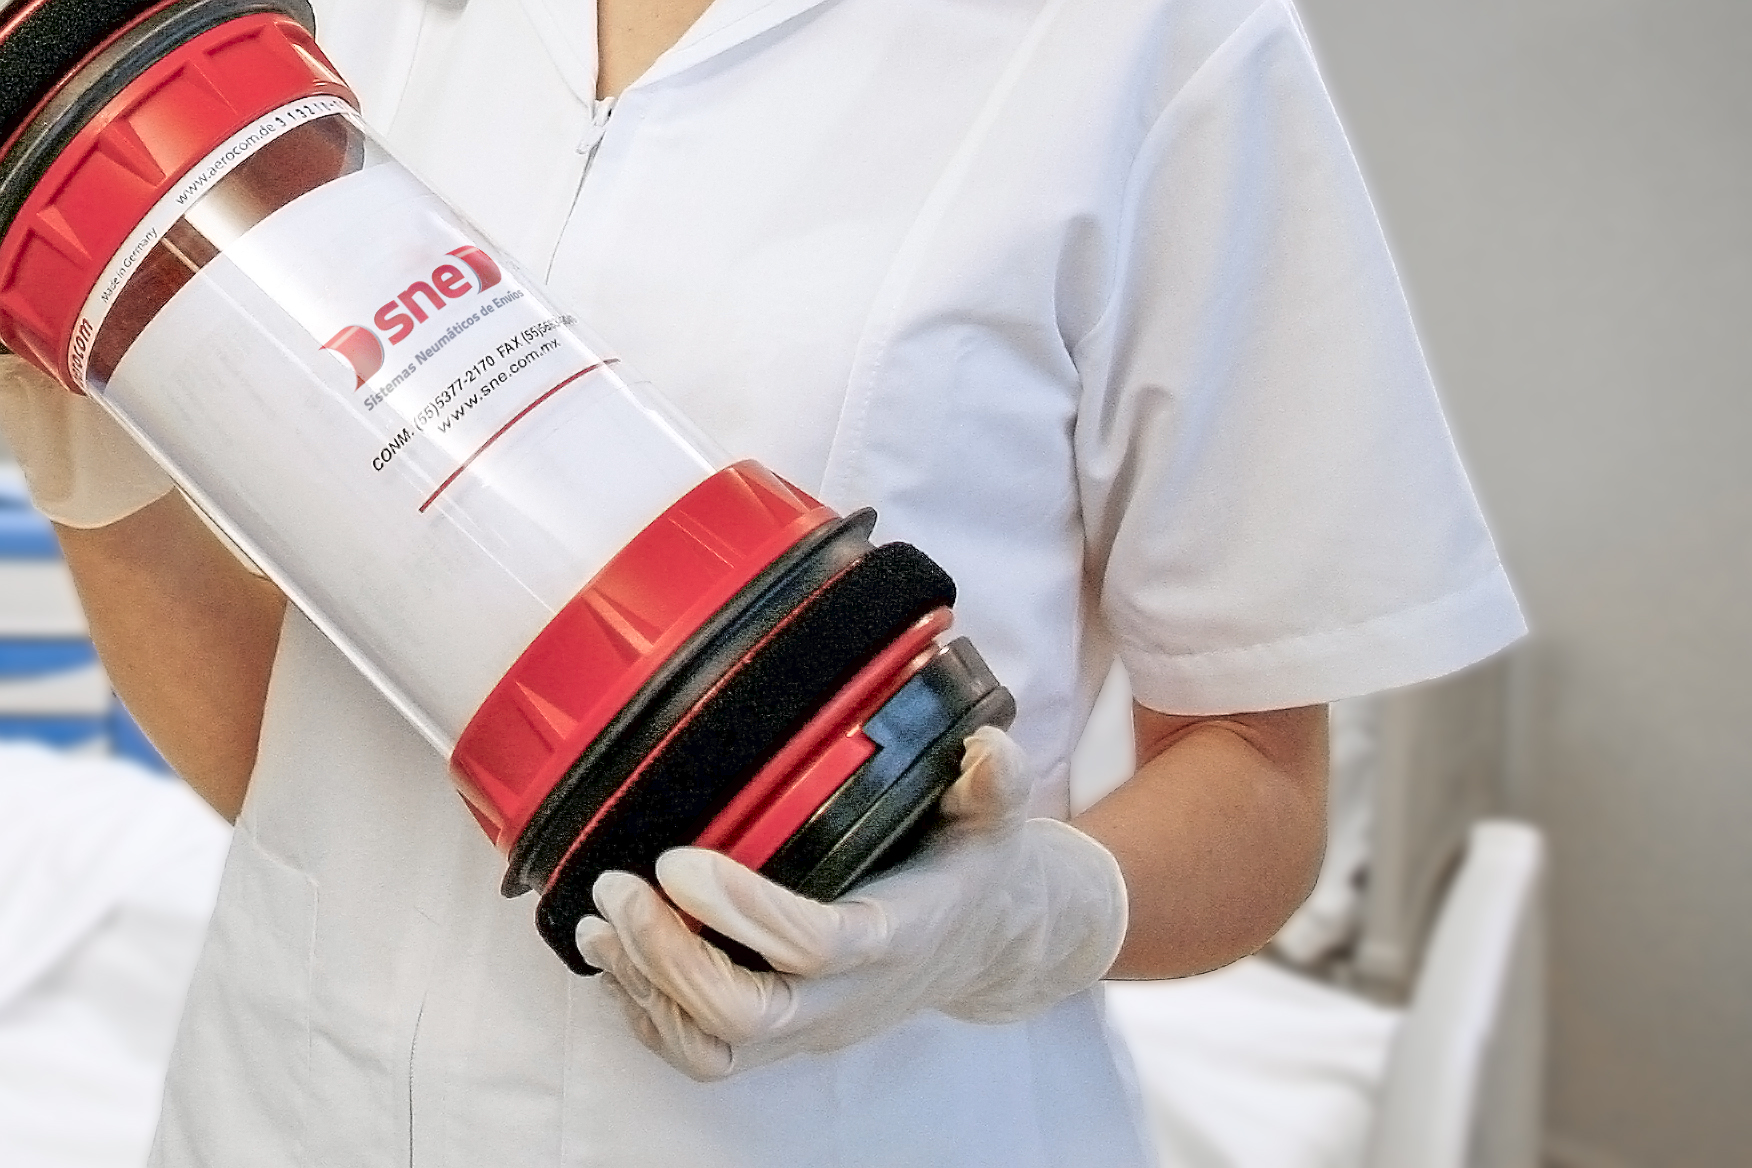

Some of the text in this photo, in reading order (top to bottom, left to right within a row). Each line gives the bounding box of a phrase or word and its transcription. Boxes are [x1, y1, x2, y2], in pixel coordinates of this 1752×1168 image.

[176, 121, 277, 205] www.aerocom.de
[100, 275, 120, 304] Made
[122, 226, 158, 267] Germany
[373, 263, 473, 346] sne
[363, 362, 416, 412] Sistemas
[414, 312, 481, 365] Neumáticos
[479, 300, 495, 318] de
[436, 337, 562, 434] www.sne.com.mx
[371, 428, 416, 472] CONM.
[412, 354, 497, 432] (55)5377-2170
[495, 335, 524, 358] FAX
